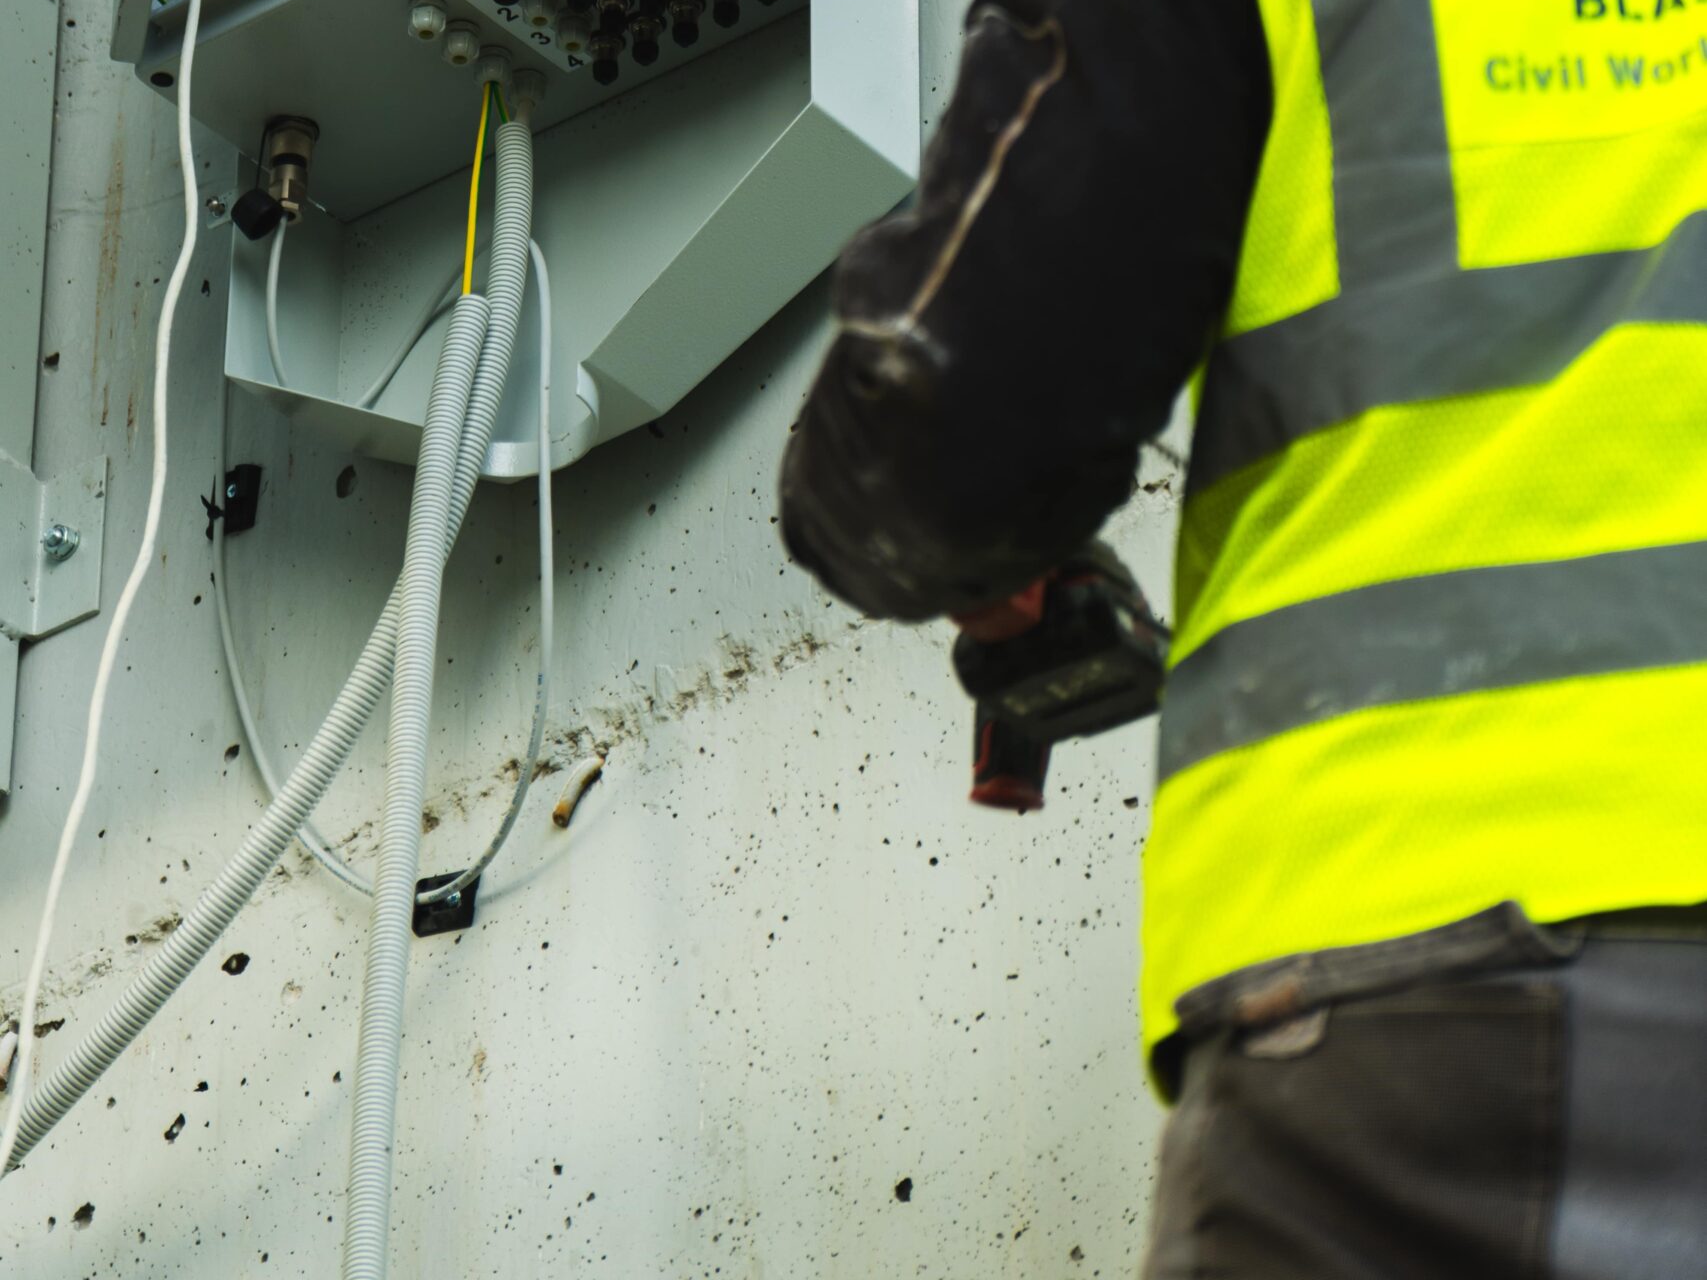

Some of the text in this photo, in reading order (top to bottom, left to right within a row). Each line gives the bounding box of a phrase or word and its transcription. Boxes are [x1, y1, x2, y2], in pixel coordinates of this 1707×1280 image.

[497, 6, 519, 22] 2
[530, 31, 551, 46] 3
[567, 53, 584, 69] 4
[1485, 55, 1586, 91] Civil
